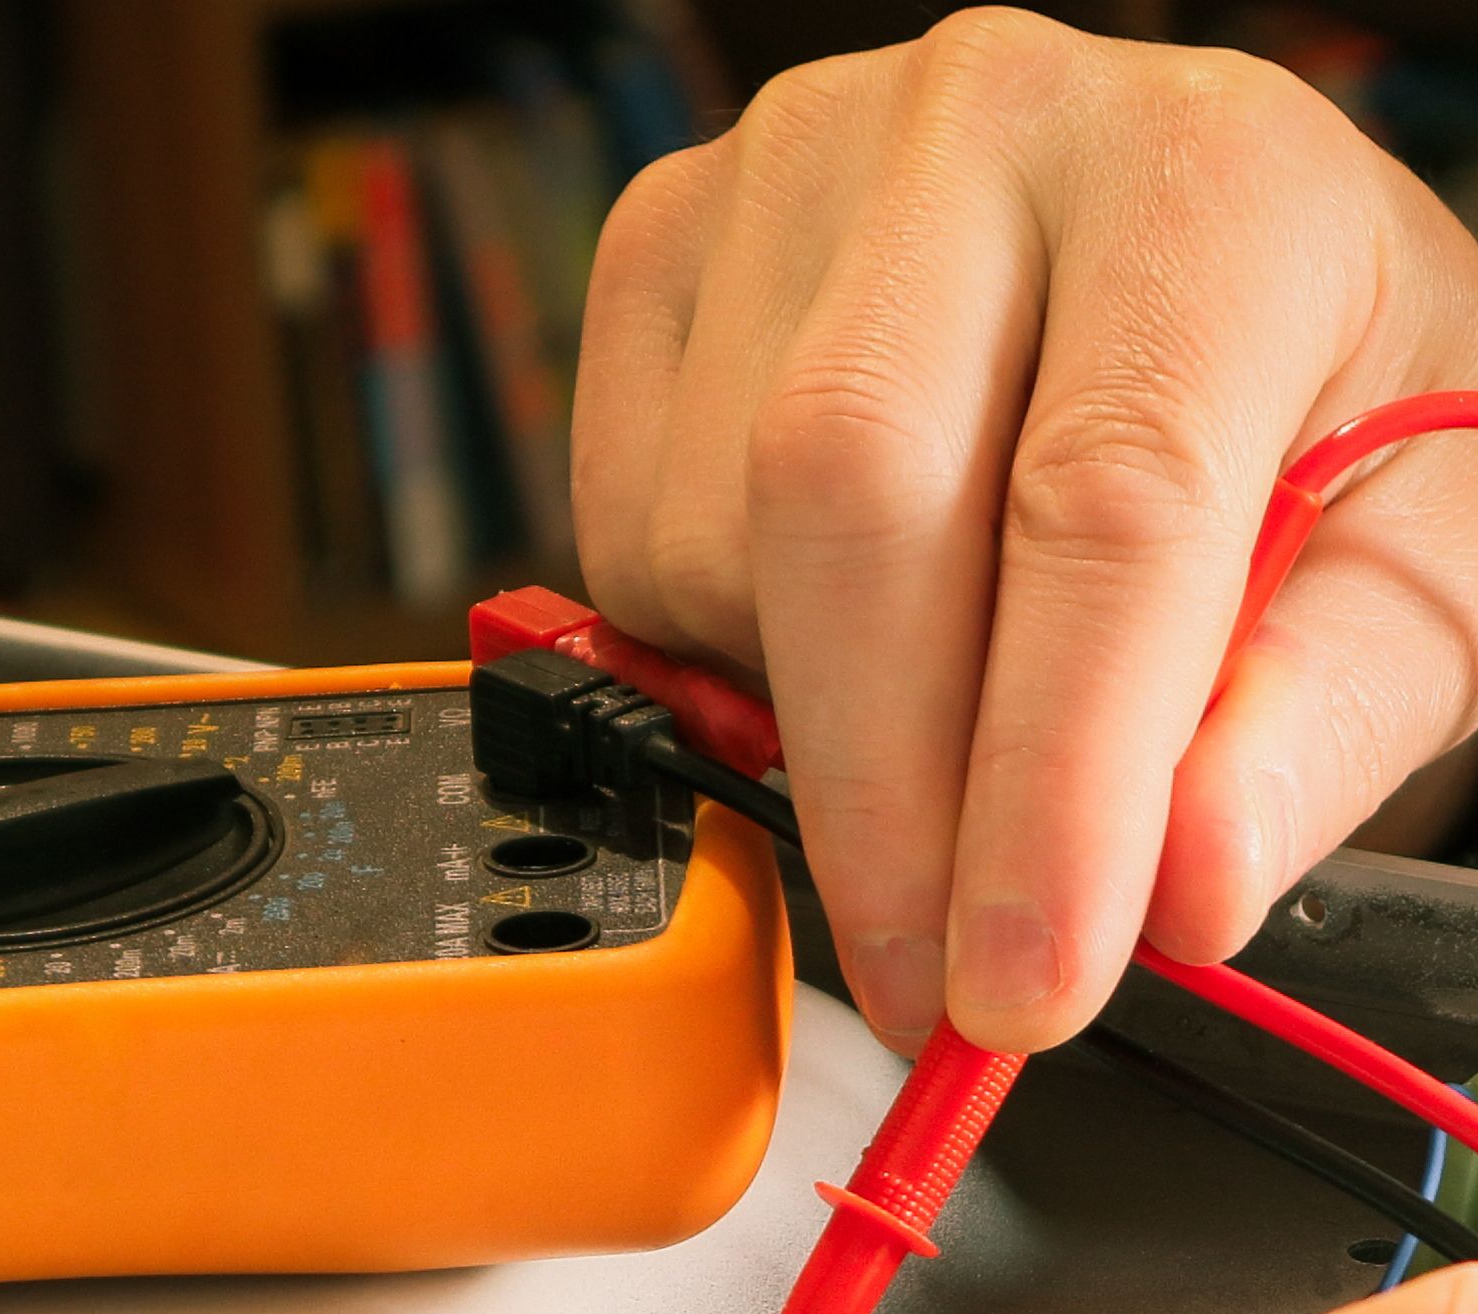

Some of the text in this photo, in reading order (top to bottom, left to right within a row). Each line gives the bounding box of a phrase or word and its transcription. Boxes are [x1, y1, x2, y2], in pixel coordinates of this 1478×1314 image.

[253, 706, 281, 752] PNP NPN
[437, 773, 471, 806] COM
[434, 901, 470, 935] MAX
